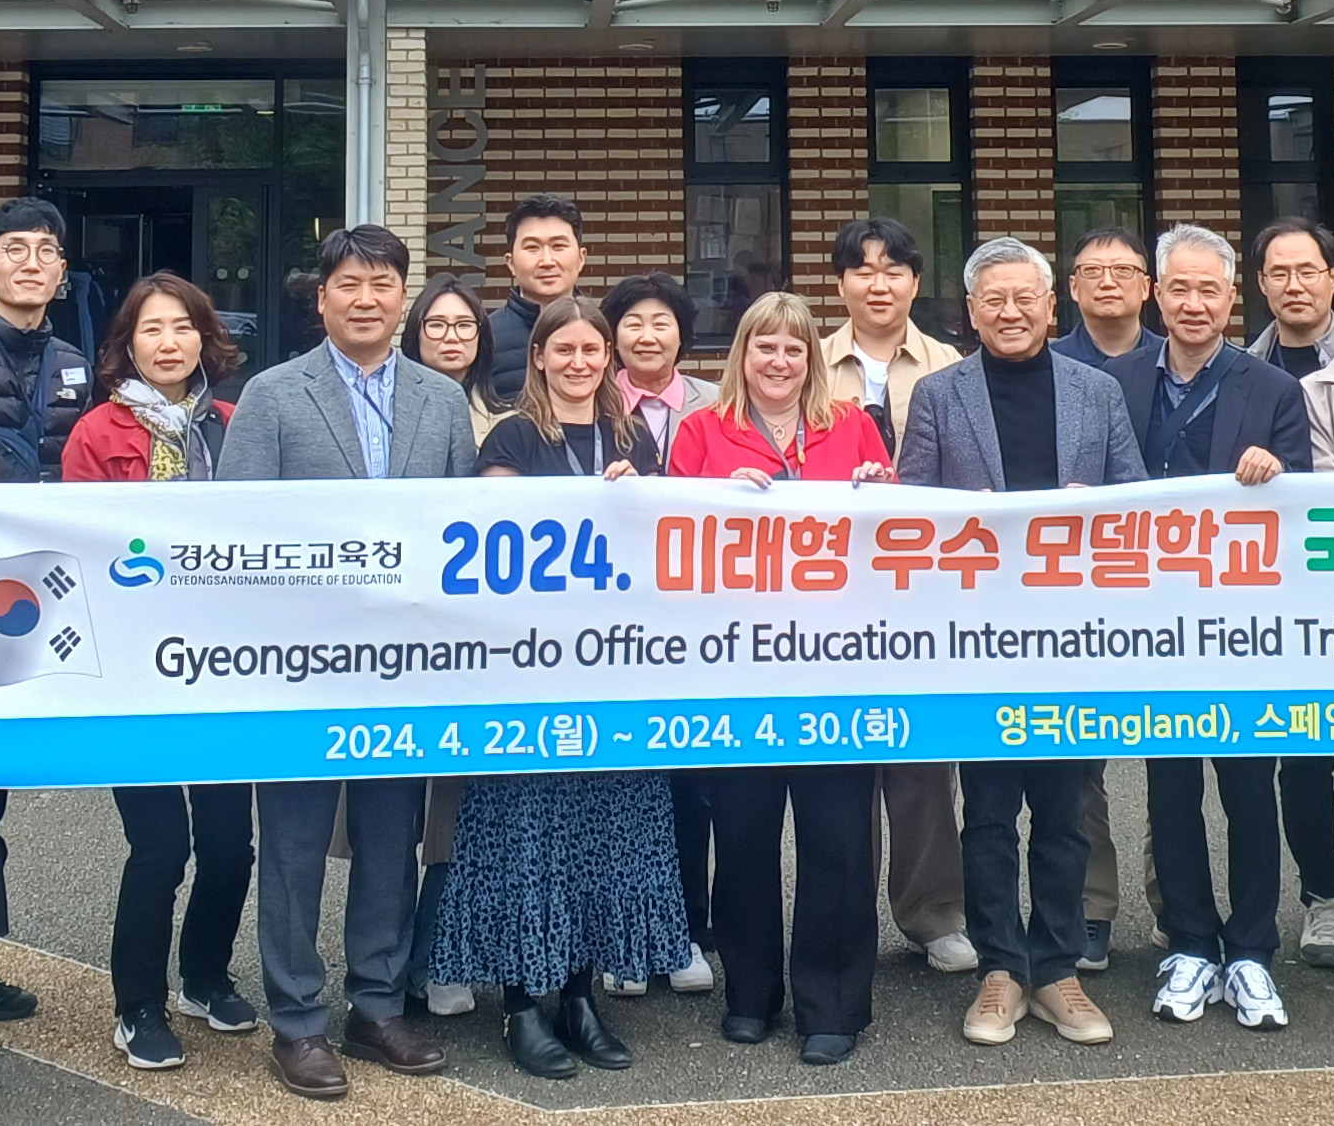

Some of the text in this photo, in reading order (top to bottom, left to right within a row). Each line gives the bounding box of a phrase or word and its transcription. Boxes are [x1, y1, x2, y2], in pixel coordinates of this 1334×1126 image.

[170, 540, 402, 572] 경상남도교육청
[170, 573, 402, 586] GYEONGSANGNAMDO OFFICE OF EDUCATION
[441, 518, 632, 595] 2024.
[656, 514, 852, 594] 미래형
[871, 517, 1000, 591] 우수
[1021, 508, 1282, 588] 모델학교
[155, 626, 563, 686] Gyeongsangnam-do
[575, 623, 687, 666] Office
[699, 621, 741, 664] of
[752, 620, 936, 662] Education
[948, 617, 1185, 660] International
[1197, 615, 1283, 657] Field
[325, 723, 424, 760] 2024.
[438, 722, 469, 756] 4.
[483, 713, 598, 758] 22.(월)
[646, 714, 742, 750] 2024.
[754, 713, 785, 748] 4.
[798, 706, 910, 750] 30.(화)
[995, 703, 1240, 746] 영국(England),
